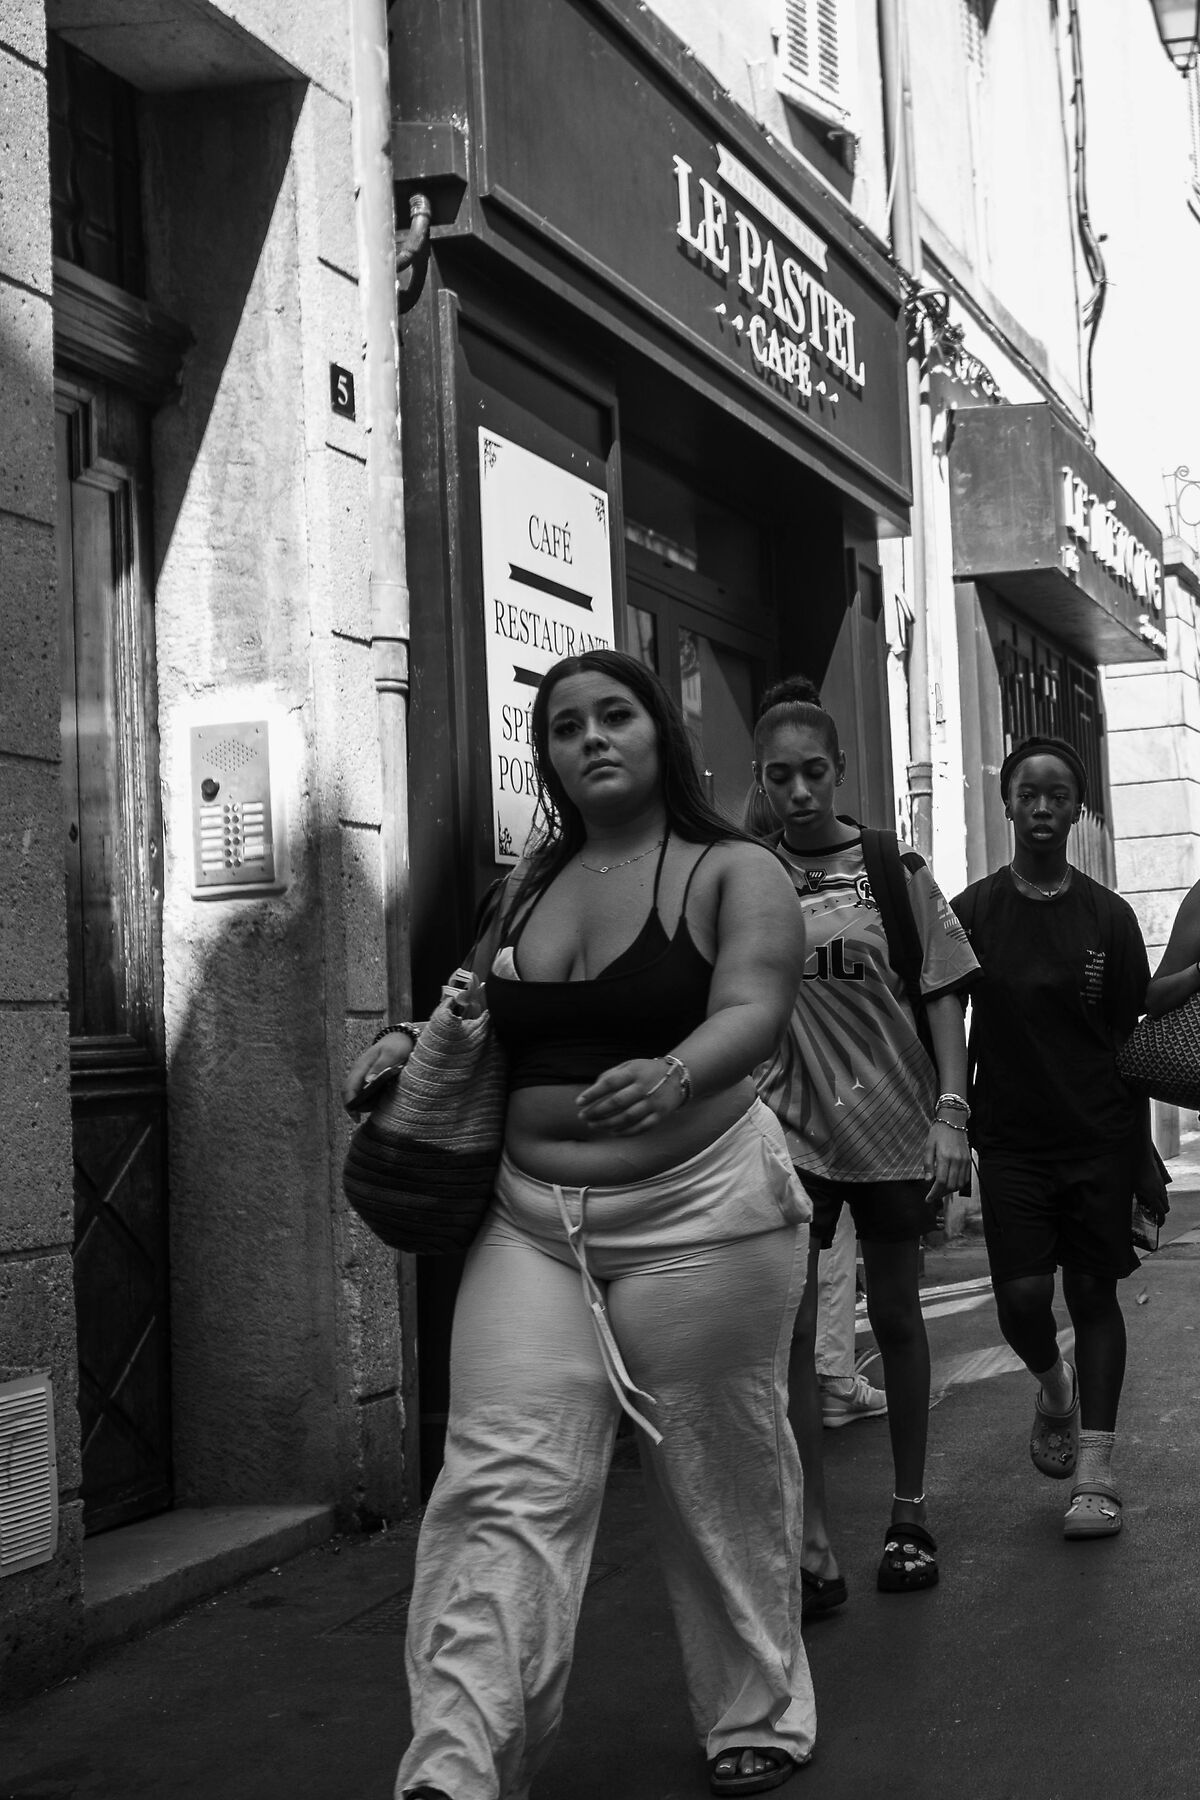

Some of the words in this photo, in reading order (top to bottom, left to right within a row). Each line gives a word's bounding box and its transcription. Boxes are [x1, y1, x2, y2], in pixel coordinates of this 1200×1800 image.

[673, 154, 730, 273] LE
[735, 210, 865, 387] PASTEL
[337, 374, 348, 406] 5
[749, 316, 812, 398] CAFÉ
[528, 514, 574, 565] CAFÉ
